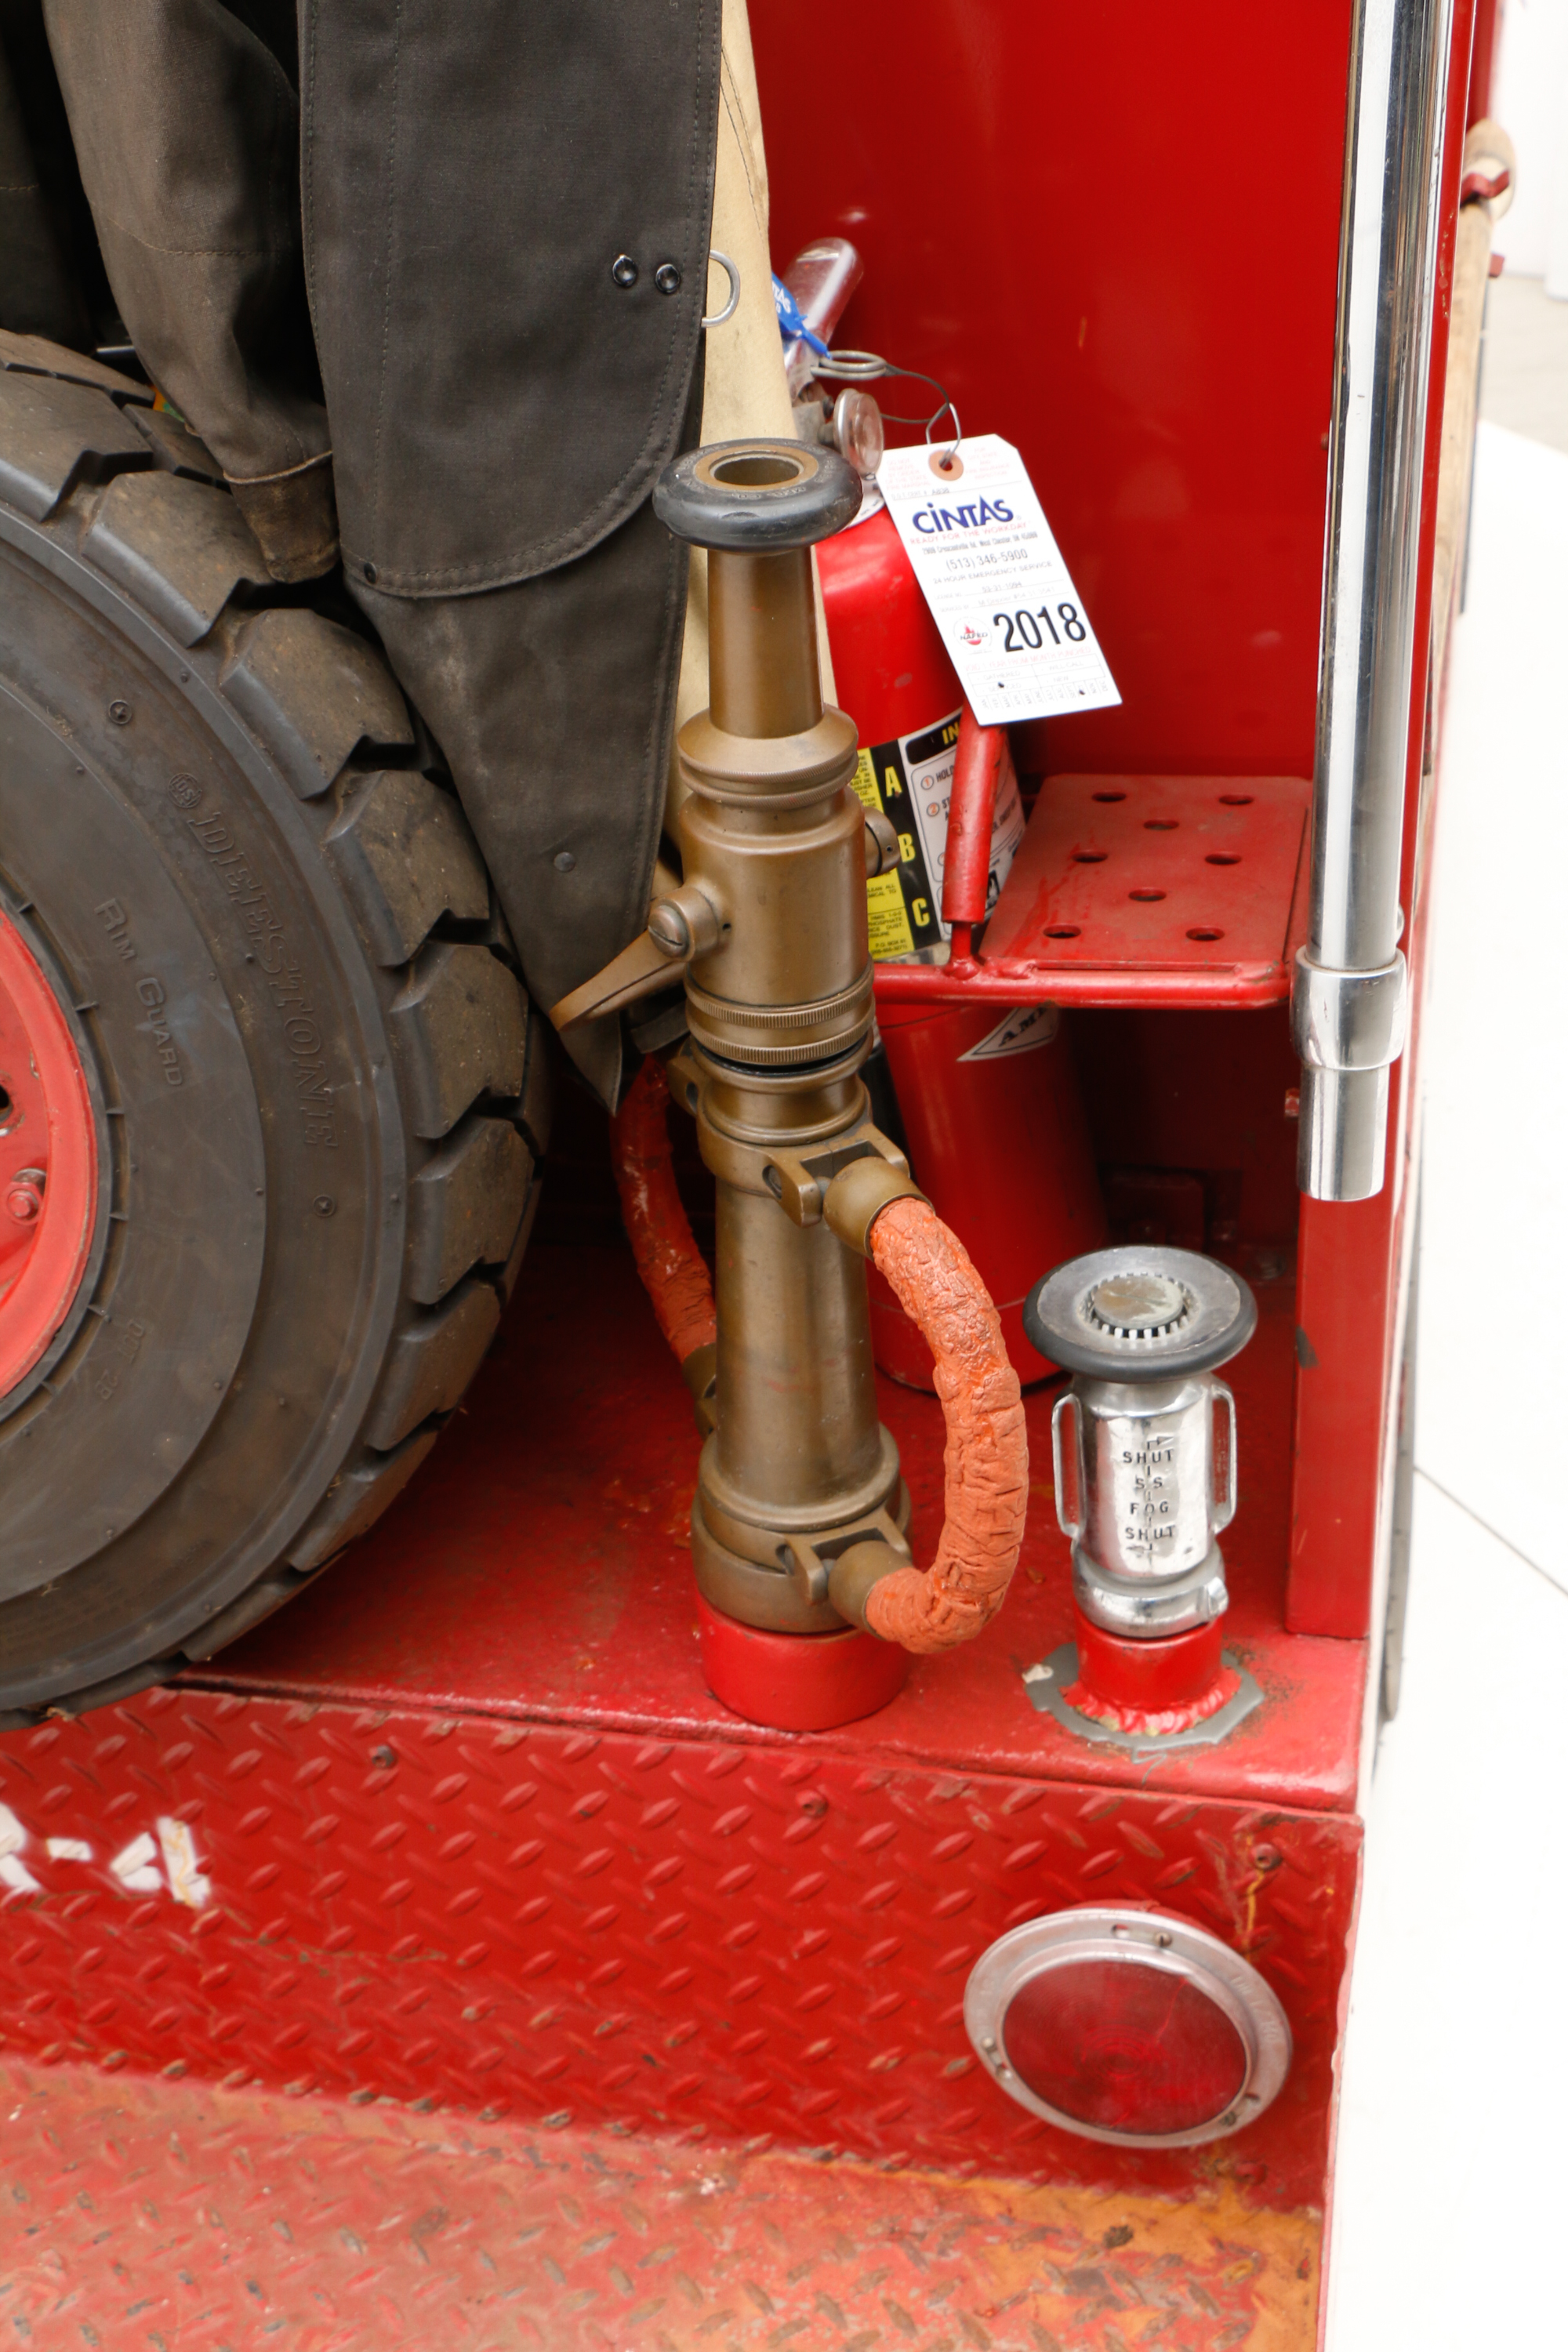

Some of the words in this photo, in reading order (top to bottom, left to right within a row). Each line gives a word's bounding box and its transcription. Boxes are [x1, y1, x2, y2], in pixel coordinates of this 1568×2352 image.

[912, 495, 1014, 534] CINTAS
[982, 521, 1026, 534] WORKDAY
[946, 557, 976, 572] (513)
[977, 549, 1028, 565] 346-5900
[968, 568, 1016, 579] EMERGENCY
[1019, 561, 1052, 571] SERVICE
[992, 601, 1087, 653] 2018
[885, 766, 902, 797] A
[898, 833, 916, 862] B
[912, 897, 931, 927] C
[95, 898, 138, 963] RIM
[134, 976, 183, 1087] GUARD
[1123, 1449, 1174, 1464] SHUT
[1130, 1501, 1170, 1515] FOG
[1125, 1524, 1176, 1541] SHUT
